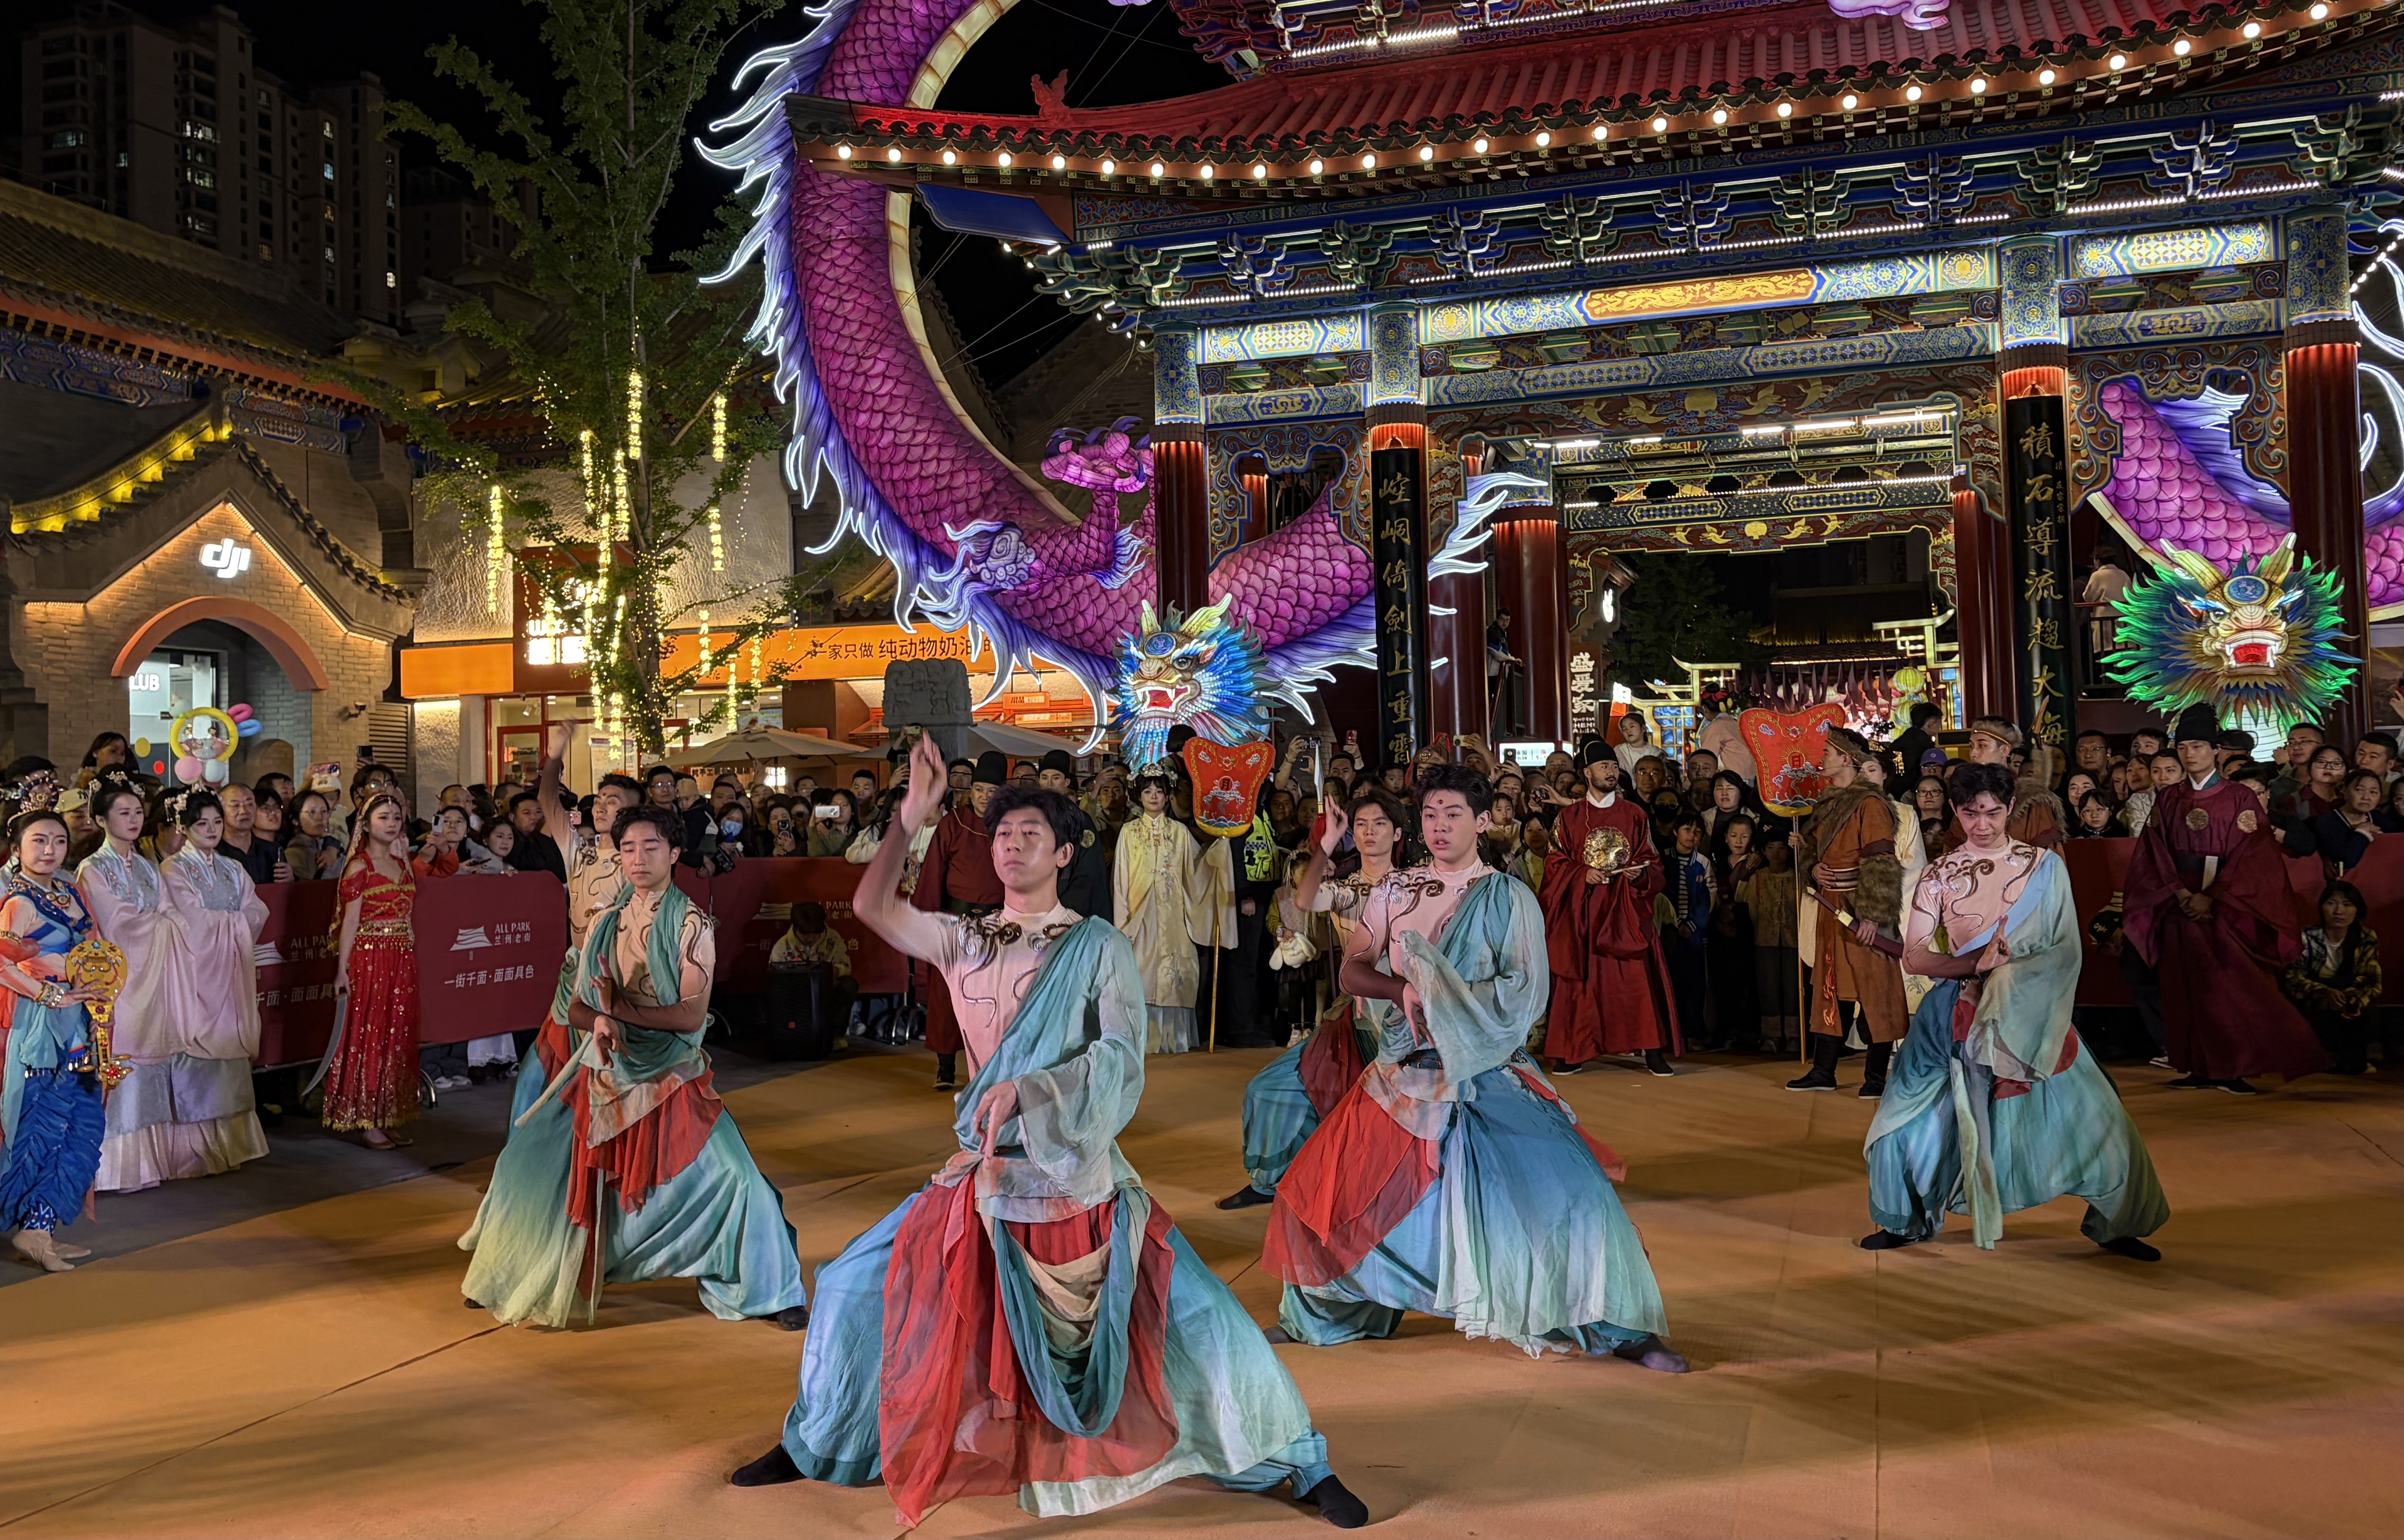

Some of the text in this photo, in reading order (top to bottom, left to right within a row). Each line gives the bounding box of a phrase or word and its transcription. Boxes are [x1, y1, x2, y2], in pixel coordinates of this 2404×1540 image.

[826, 901, 851, 910] PARK
[495, 921, 531, 934] ALL PARK
